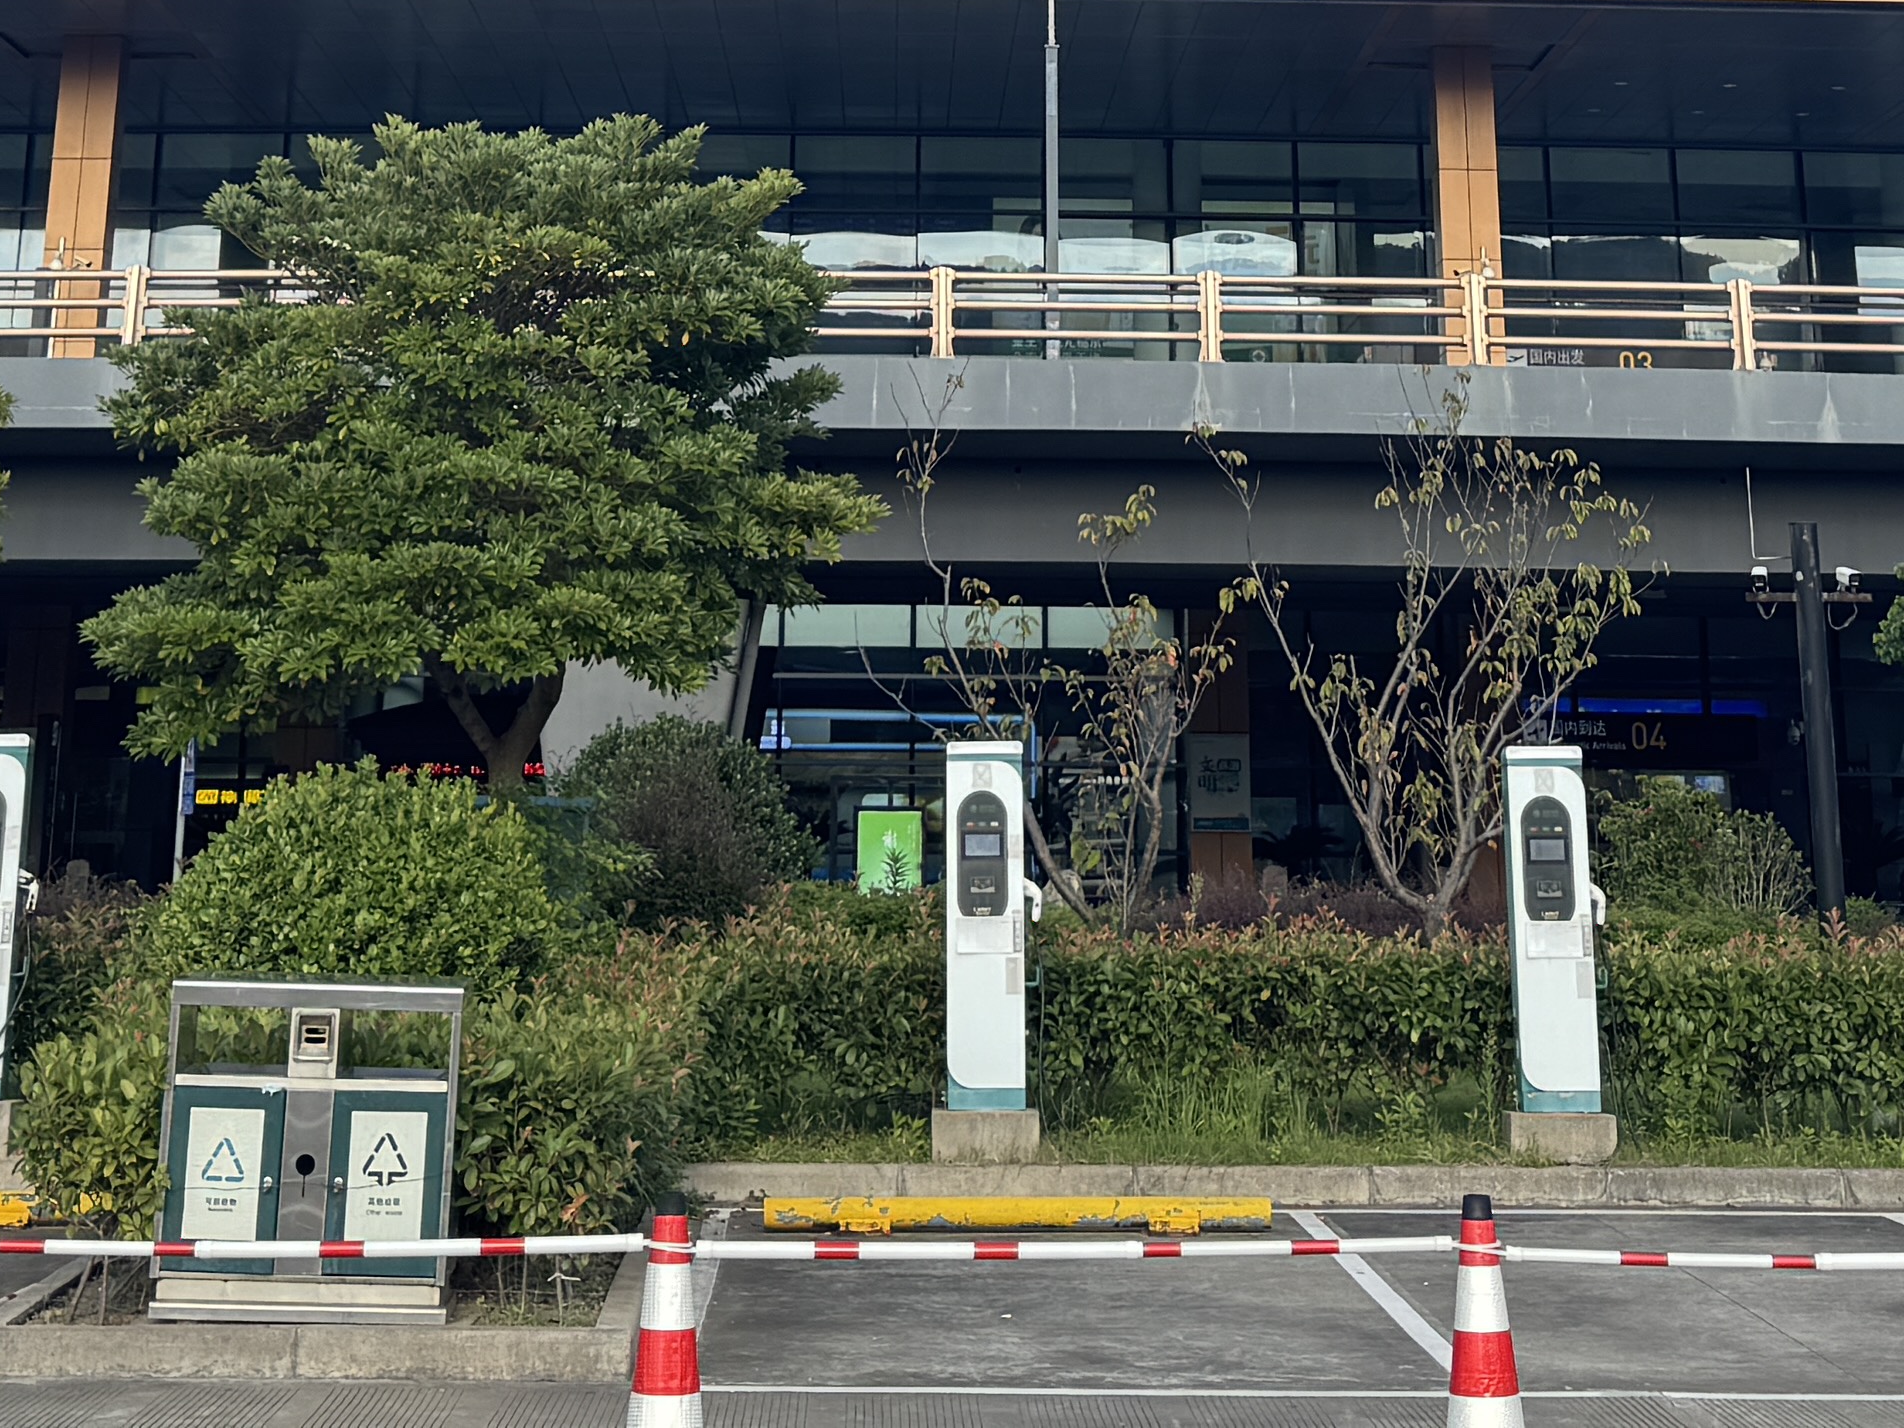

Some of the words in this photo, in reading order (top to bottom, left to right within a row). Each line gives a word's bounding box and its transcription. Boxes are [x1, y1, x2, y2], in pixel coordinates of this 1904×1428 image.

[1529, 348, 1585, 365] 国内出发
[1550, 719, 1607, 736] 国内到达
[1631, 721, 1667, 750] 04
